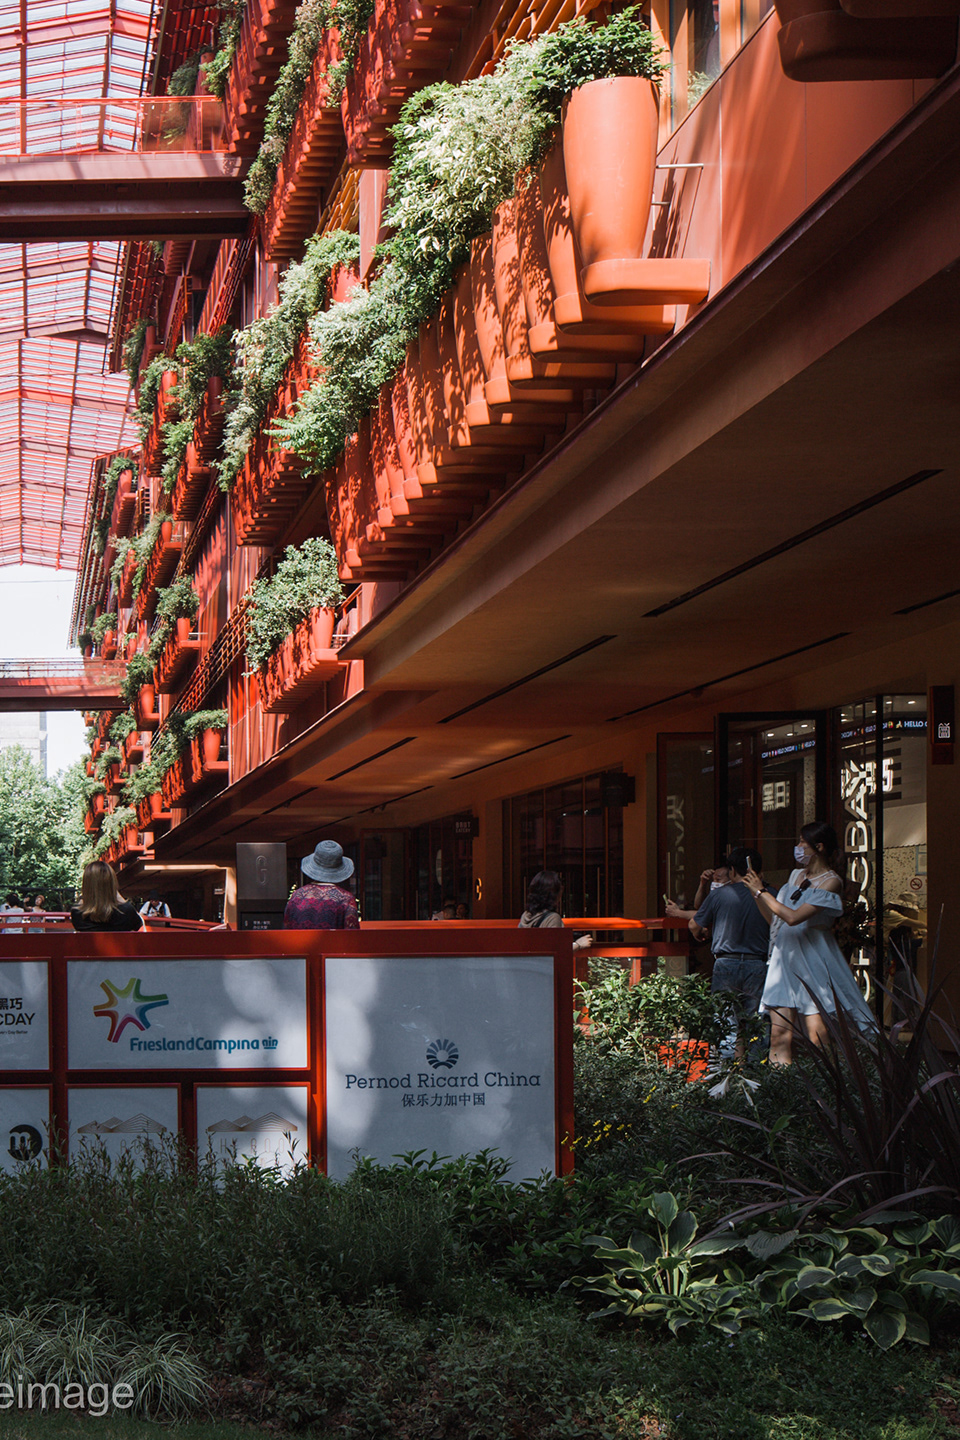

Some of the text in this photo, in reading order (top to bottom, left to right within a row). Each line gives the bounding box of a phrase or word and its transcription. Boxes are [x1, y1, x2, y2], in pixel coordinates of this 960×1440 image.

[130, 1036, 260, 1054] FrieslandCampina
[345, 1072, 541, 1089] Pernod Ricard China
[401, 1093, 485, 1107] 保乐力加中国
